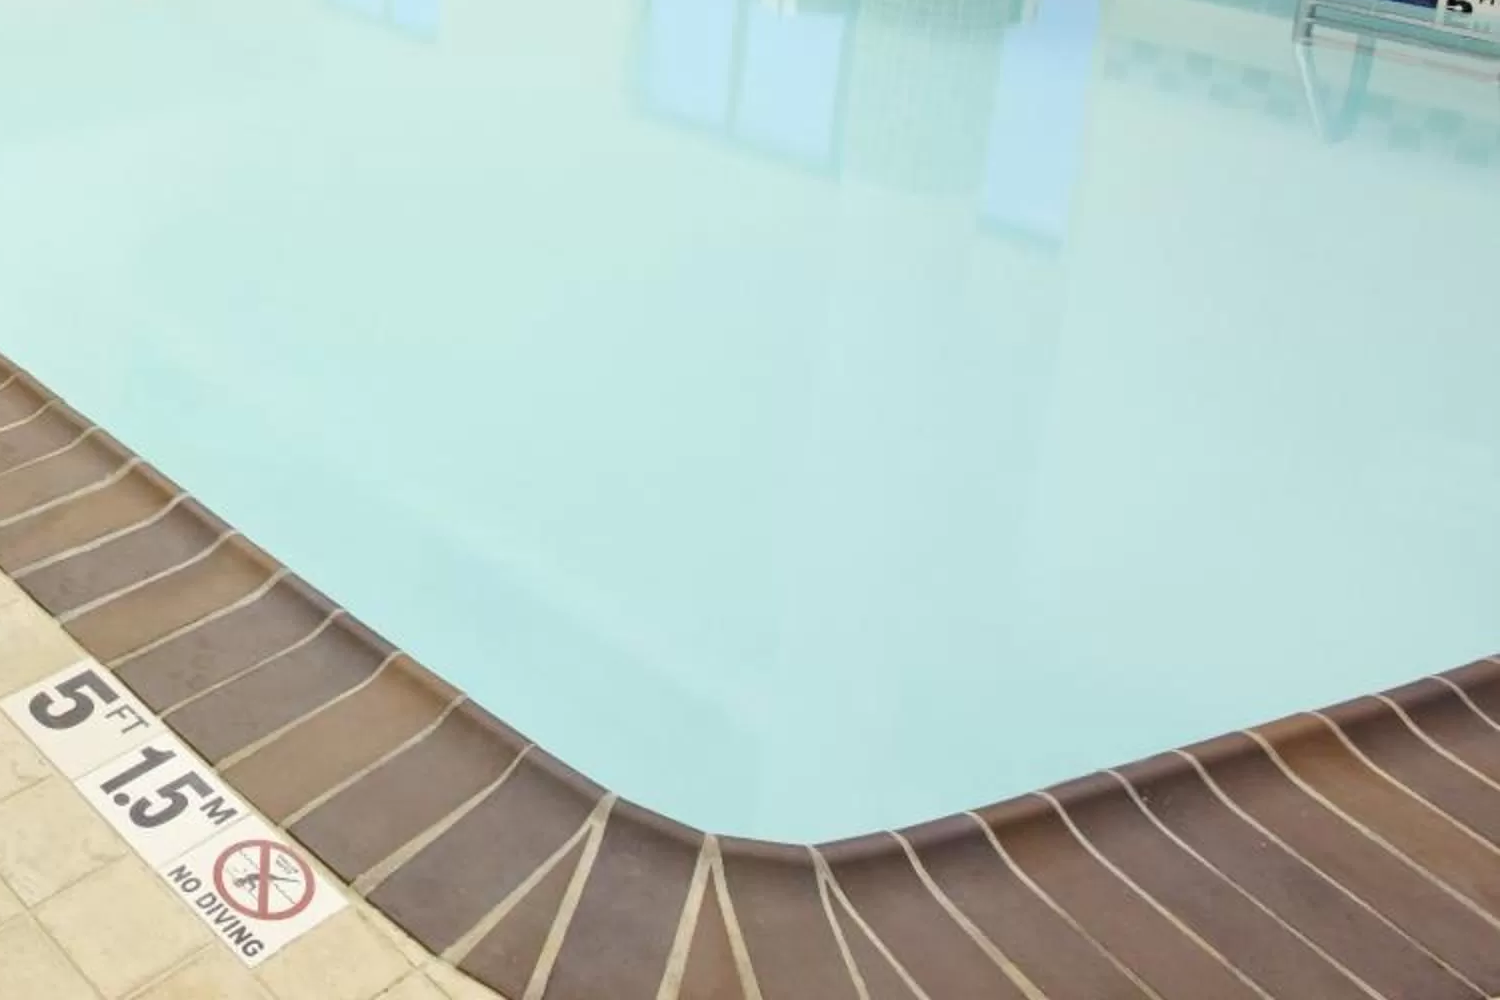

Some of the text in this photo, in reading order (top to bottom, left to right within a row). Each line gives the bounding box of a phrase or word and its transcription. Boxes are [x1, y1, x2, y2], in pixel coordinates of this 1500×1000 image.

[29, 669, 238, 829] 5 FT 1.5 M
[167, 864, 265, 958] NO DIVING
